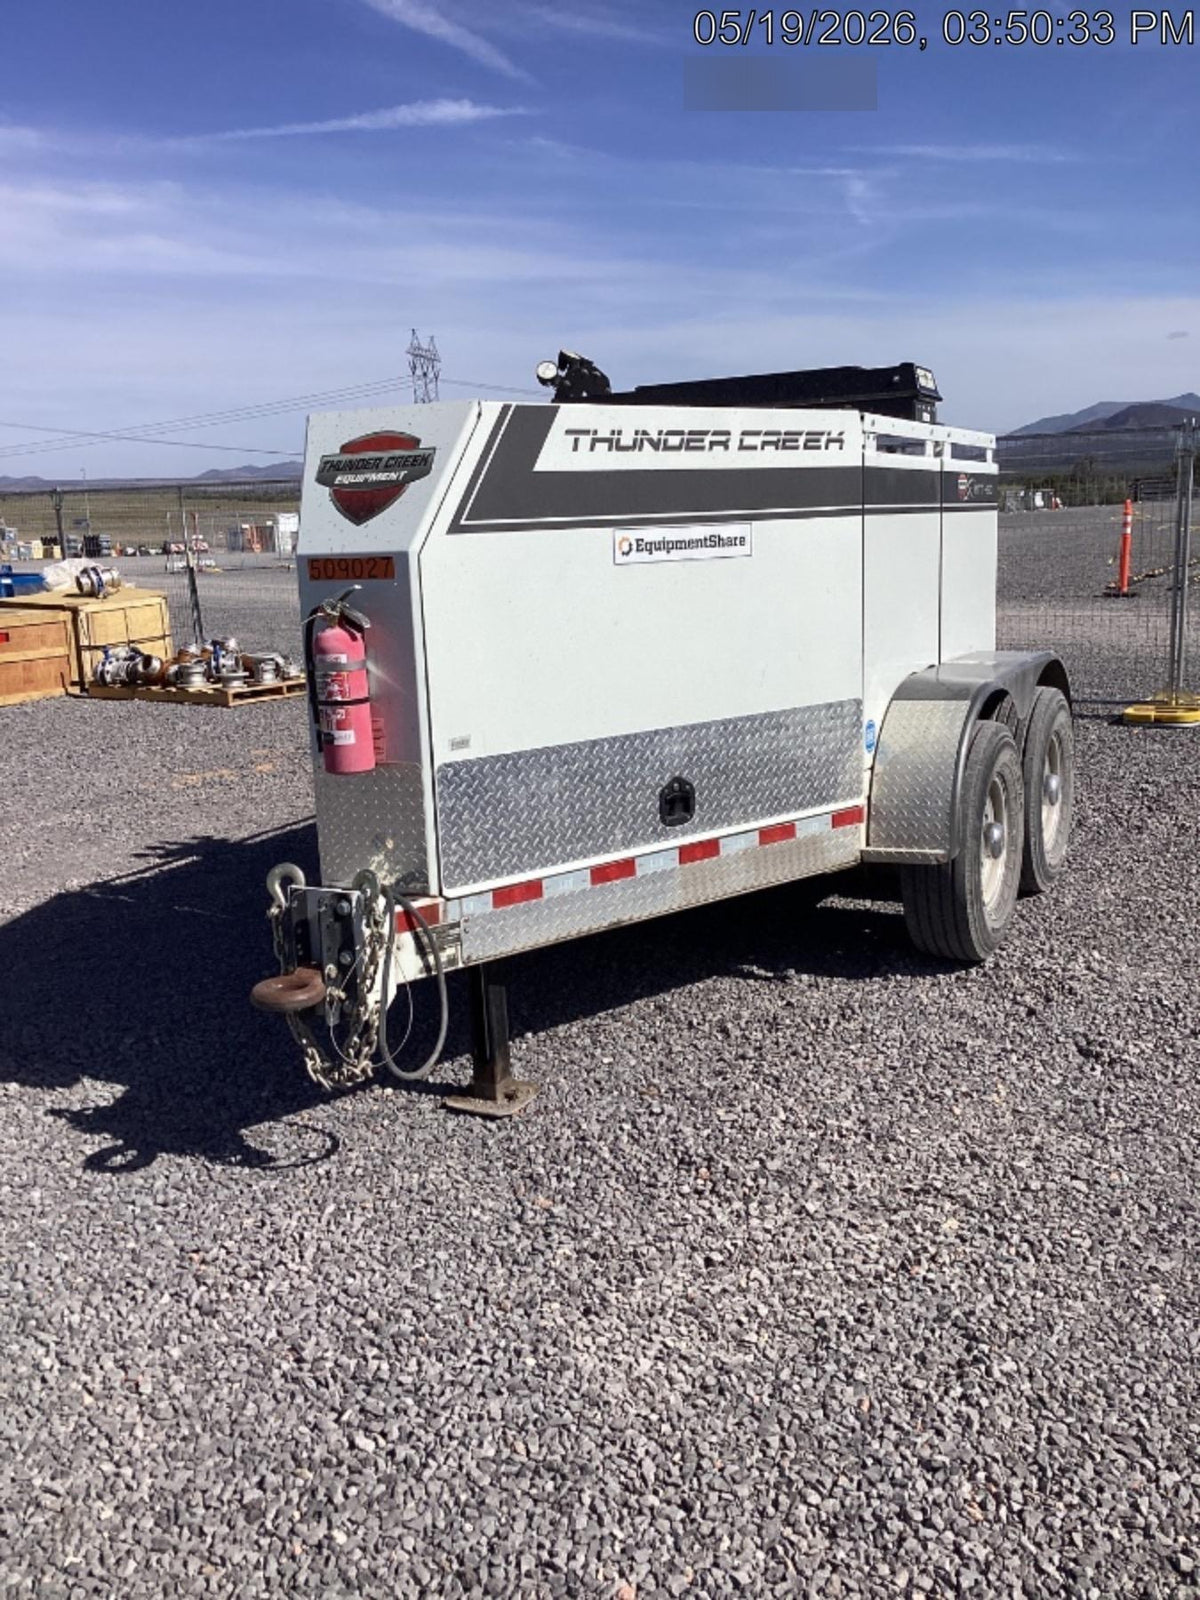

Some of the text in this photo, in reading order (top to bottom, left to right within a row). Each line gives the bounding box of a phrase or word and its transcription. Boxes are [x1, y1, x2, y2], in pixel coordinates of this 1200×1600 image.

[564, 429, 846, 452] THUNDER CREEK
[321, 453, 430, 473] THUNDER CREEK
[334, 470, 408, 485] EQUIPMENT
[635, 534, 746, 554] EquipmentShare
[310, 558, 393, 580] 509027
